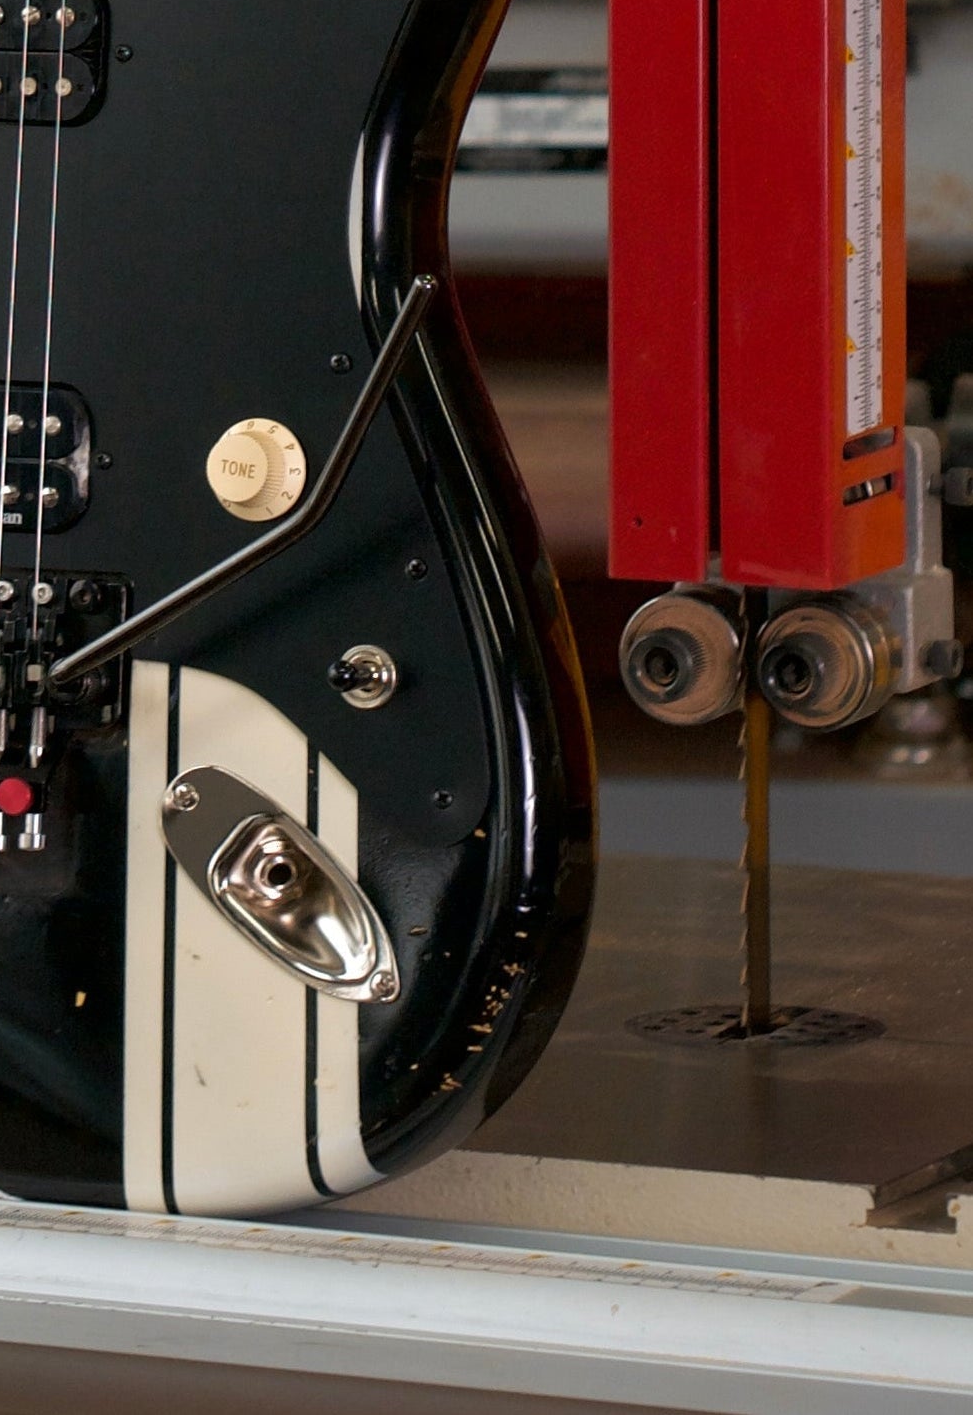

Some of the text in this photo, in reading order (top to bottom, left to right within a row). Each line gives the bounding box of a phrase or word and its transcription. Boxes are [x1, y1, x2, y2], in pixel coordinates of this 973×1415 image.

[284, 443, 295, 451] 4
[221, 459, 255, 479] TONE
[289, 467, 302, 476] 3
[281, 490, 294, 500] 2
